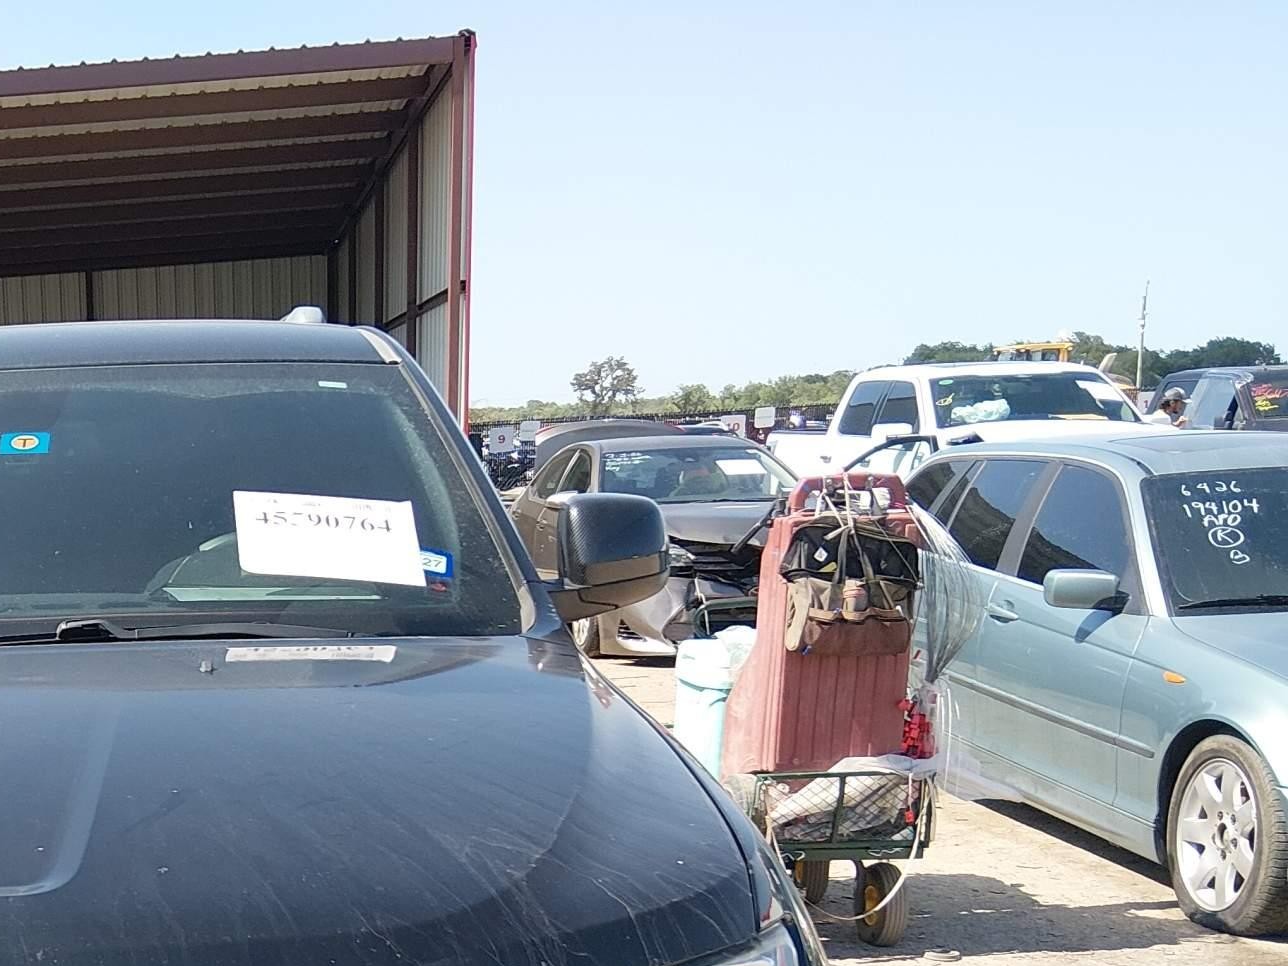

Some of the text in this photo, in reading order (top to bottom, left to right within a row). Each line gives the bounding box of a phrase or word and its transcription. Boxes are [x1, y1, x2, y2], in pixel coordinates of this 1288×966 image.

[16, 437, 35, 448] T
[497, 434, 506, 444] 9
[422, 556, 443, 568] 27
